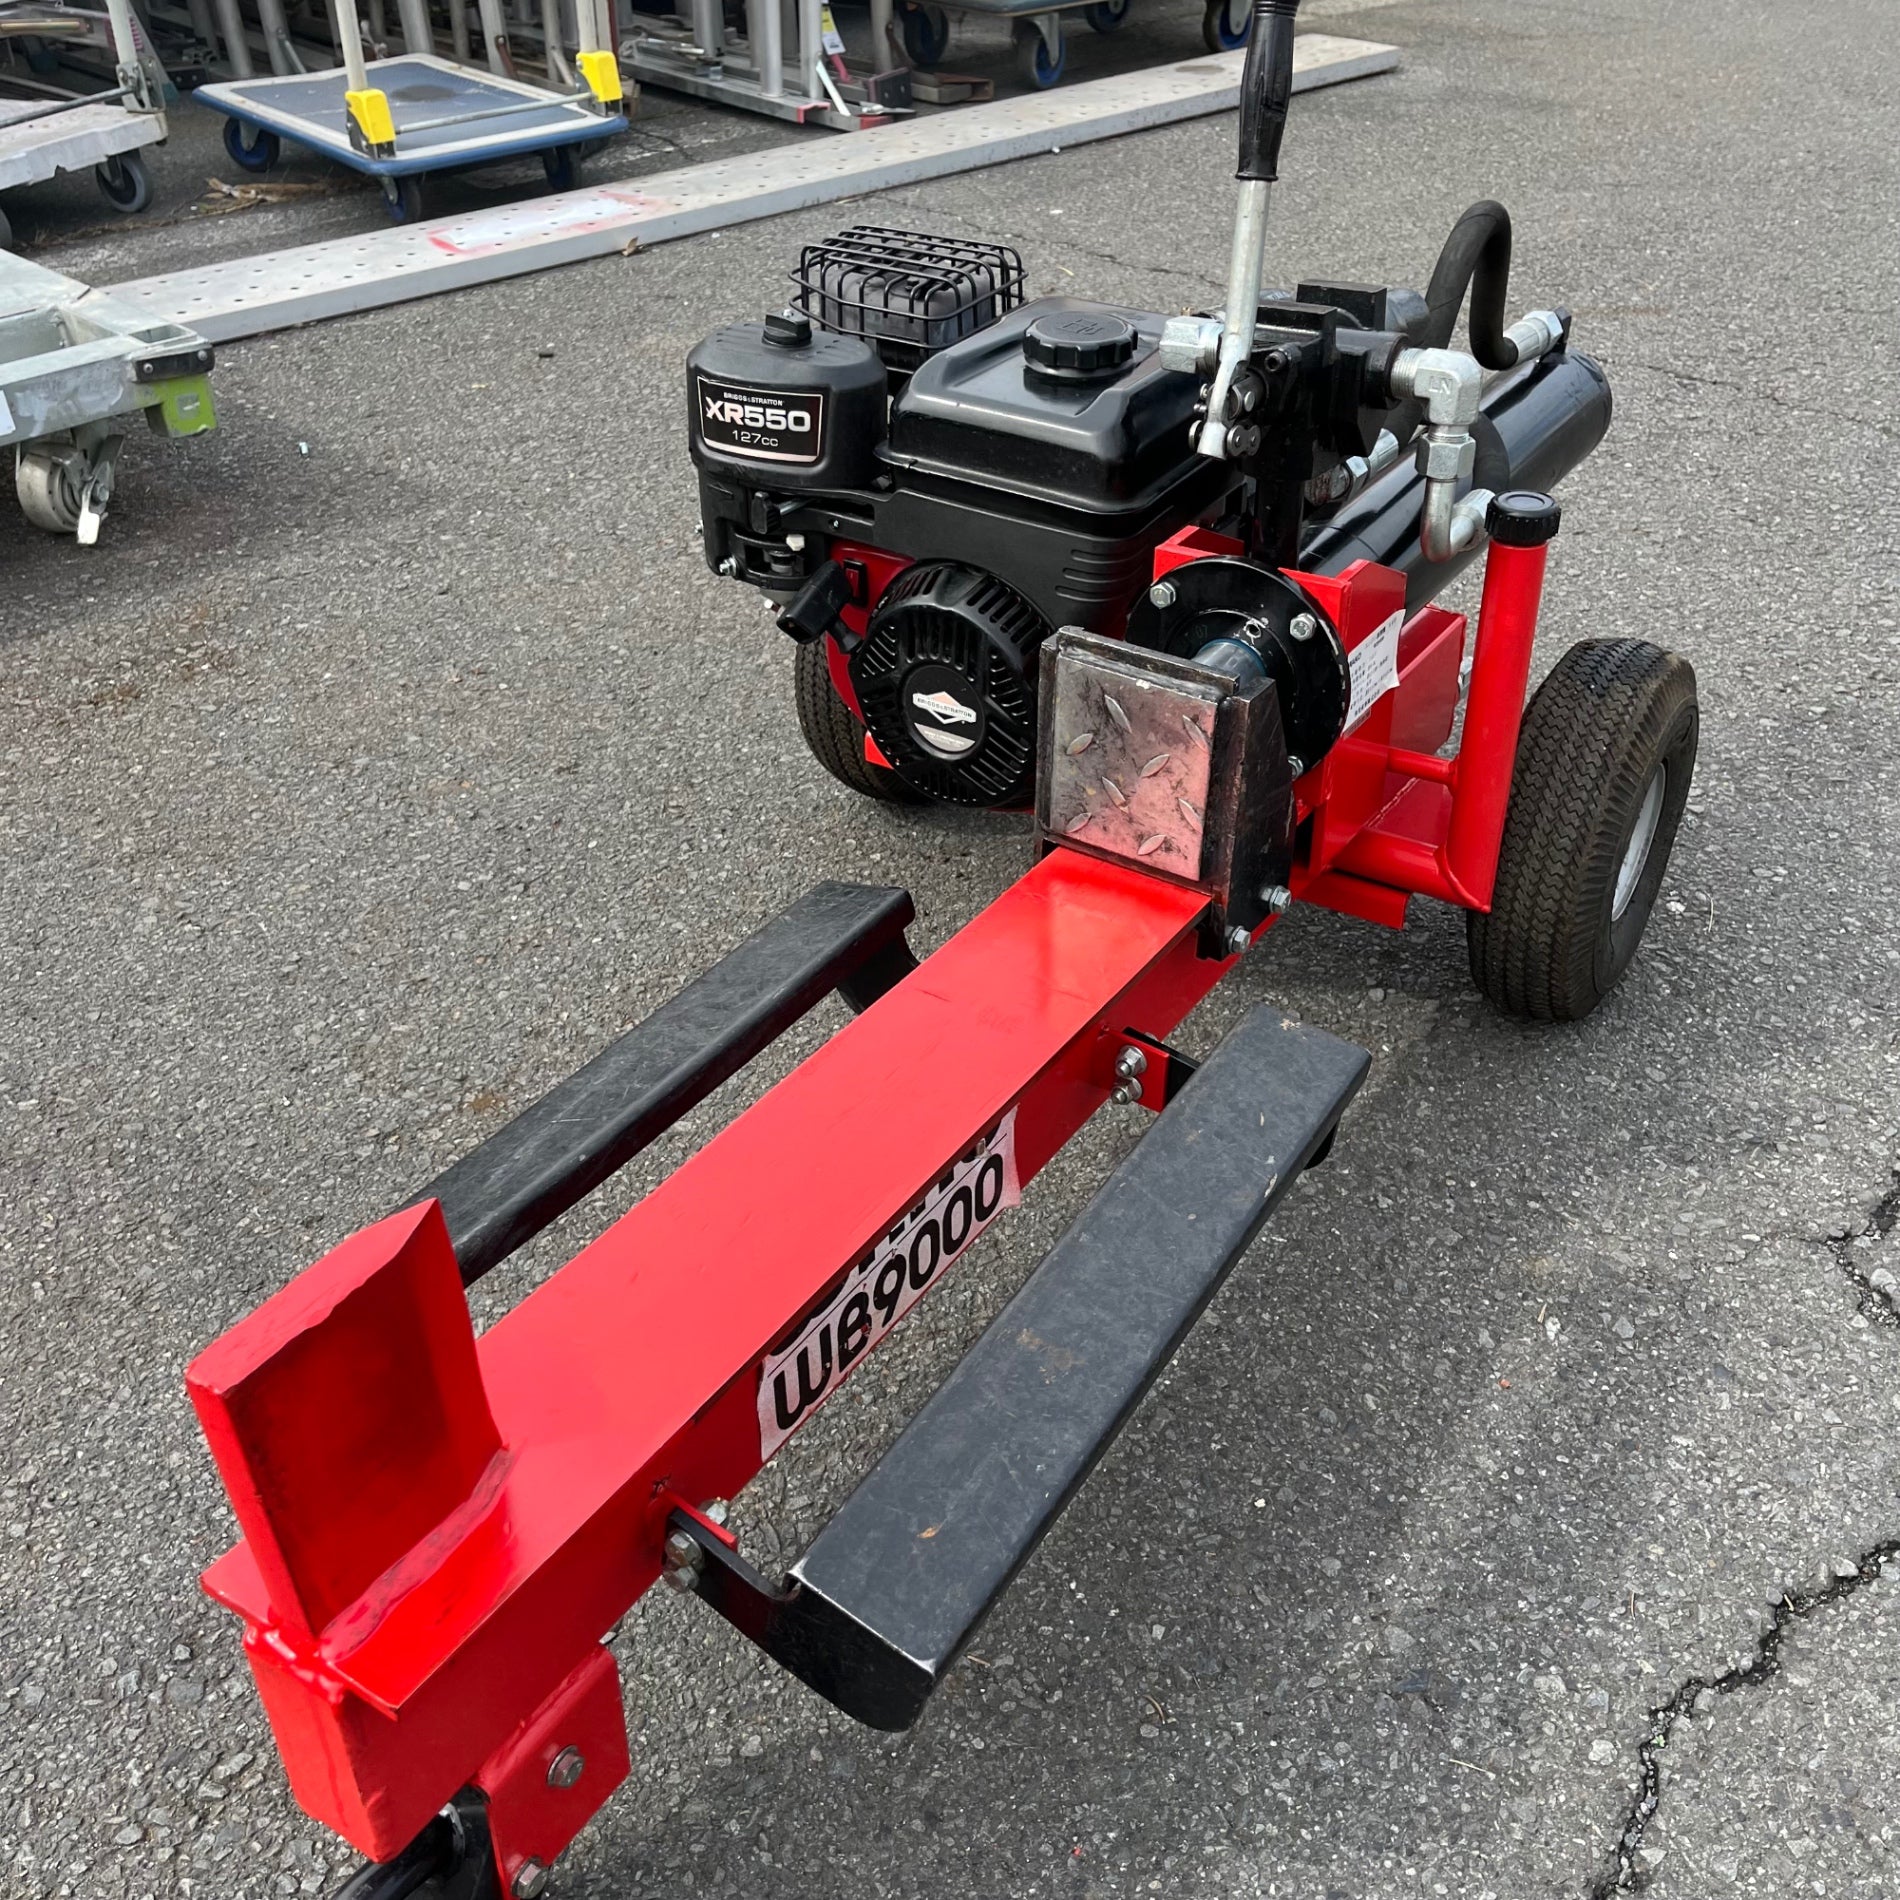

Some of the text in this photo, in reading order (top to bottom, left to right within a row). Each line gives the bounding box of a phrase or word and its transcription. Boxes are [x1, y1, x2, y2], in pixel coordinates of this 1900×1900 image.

[705, 397, 811, 432] XR550
[732, 430, 779, 447] 127cc
[773, 1153, 1004, 1430] WB9000
